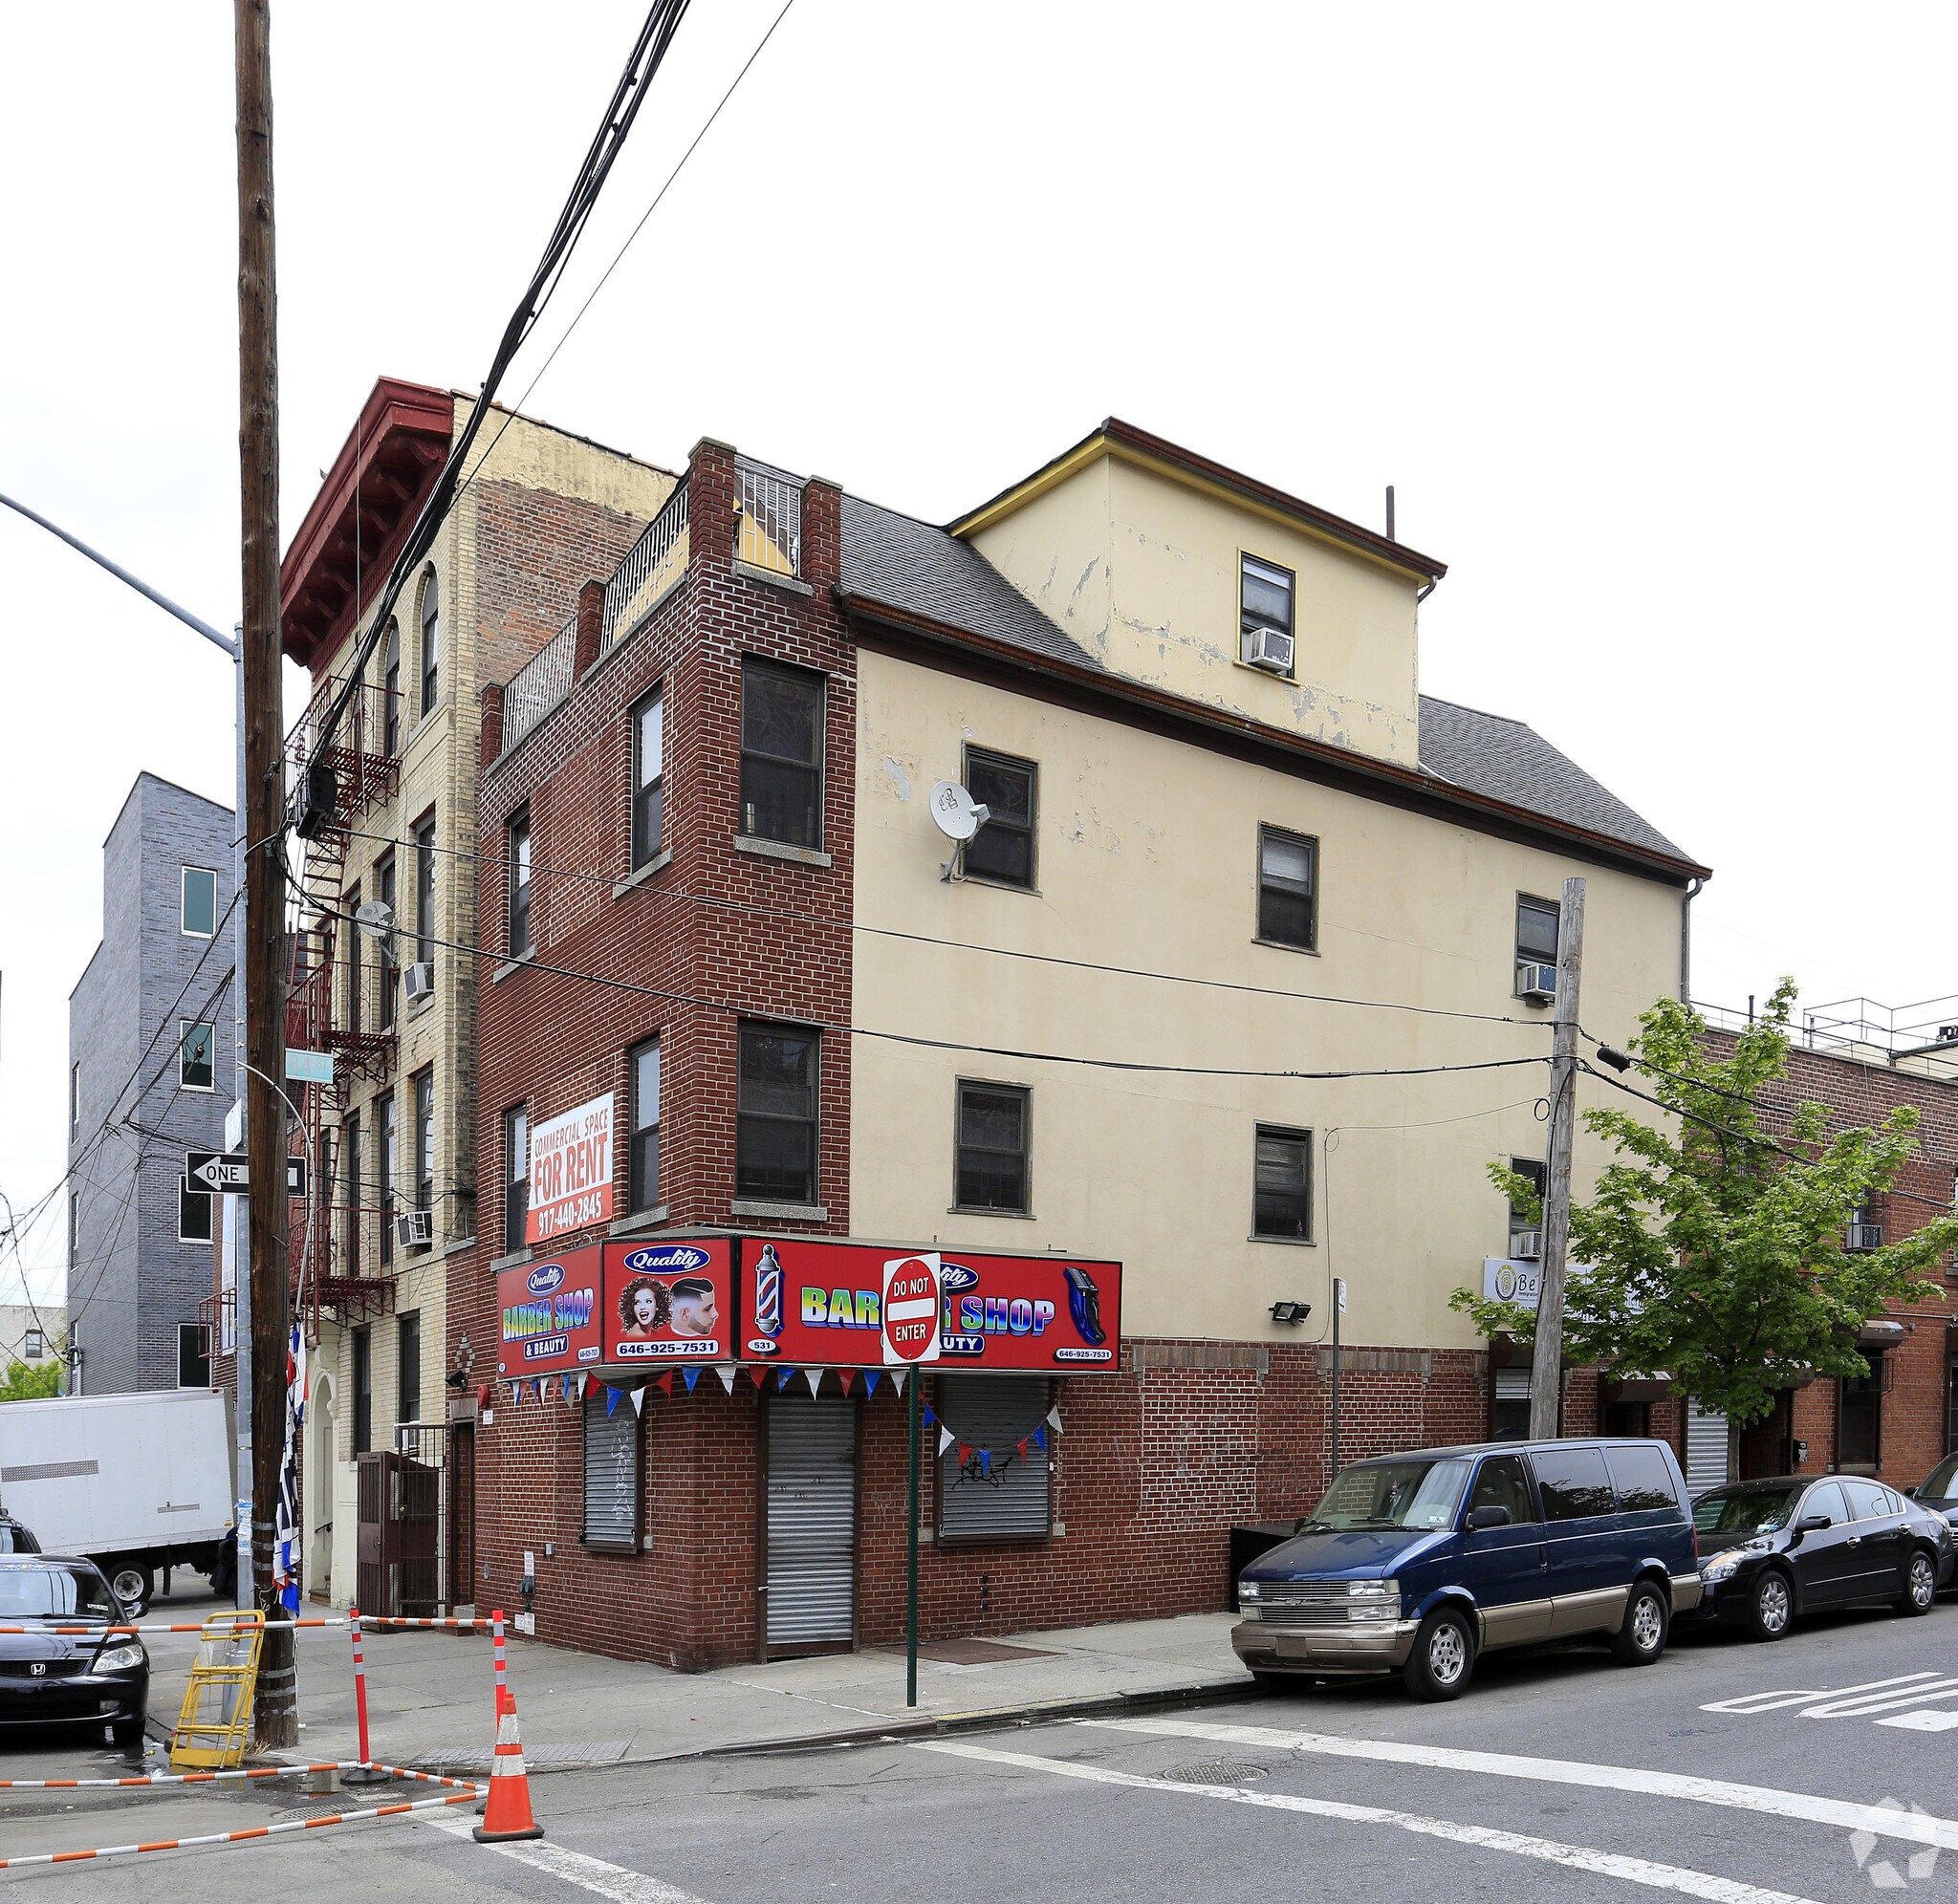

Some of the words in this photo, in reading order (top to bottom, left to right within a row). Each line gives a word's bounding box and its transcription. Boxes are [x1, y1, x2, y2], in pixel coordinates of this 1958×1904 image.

[534, 1121, 580, 1158] COMMERCIAL
[584, 1108, 609, 1137] SPACE
[207, 1165, 239, 1181] ONE
[534, 1152, 562, 1204] FOR
[566, 1132, 608, 1193] RENT
[538, 1192, 602, 1237] 917-440-2845
[633, 1248, 701, 1268] Quality
[530, 1267, 561, 1289] Quality
[893, 1280, 907, 1297] DO
[910, 1276, 929, 1295] NOT
[503, 1298, 552, 1341] BARBER
[555, 1287, 594, 1330] SHOP
[961, 1295, 1055, 1334] SHOP
[895, 1323, 926, 1342] ENTER
[526, 1344, 533, 1356] &
[533, 1337, 566, 1355] BEAUTY
[620, 1342, 714, 1354] 646-925-7531
[753, 1341, 771, 1350] 531
[1059, 1351, 1110, 1359] 646-925-7531
